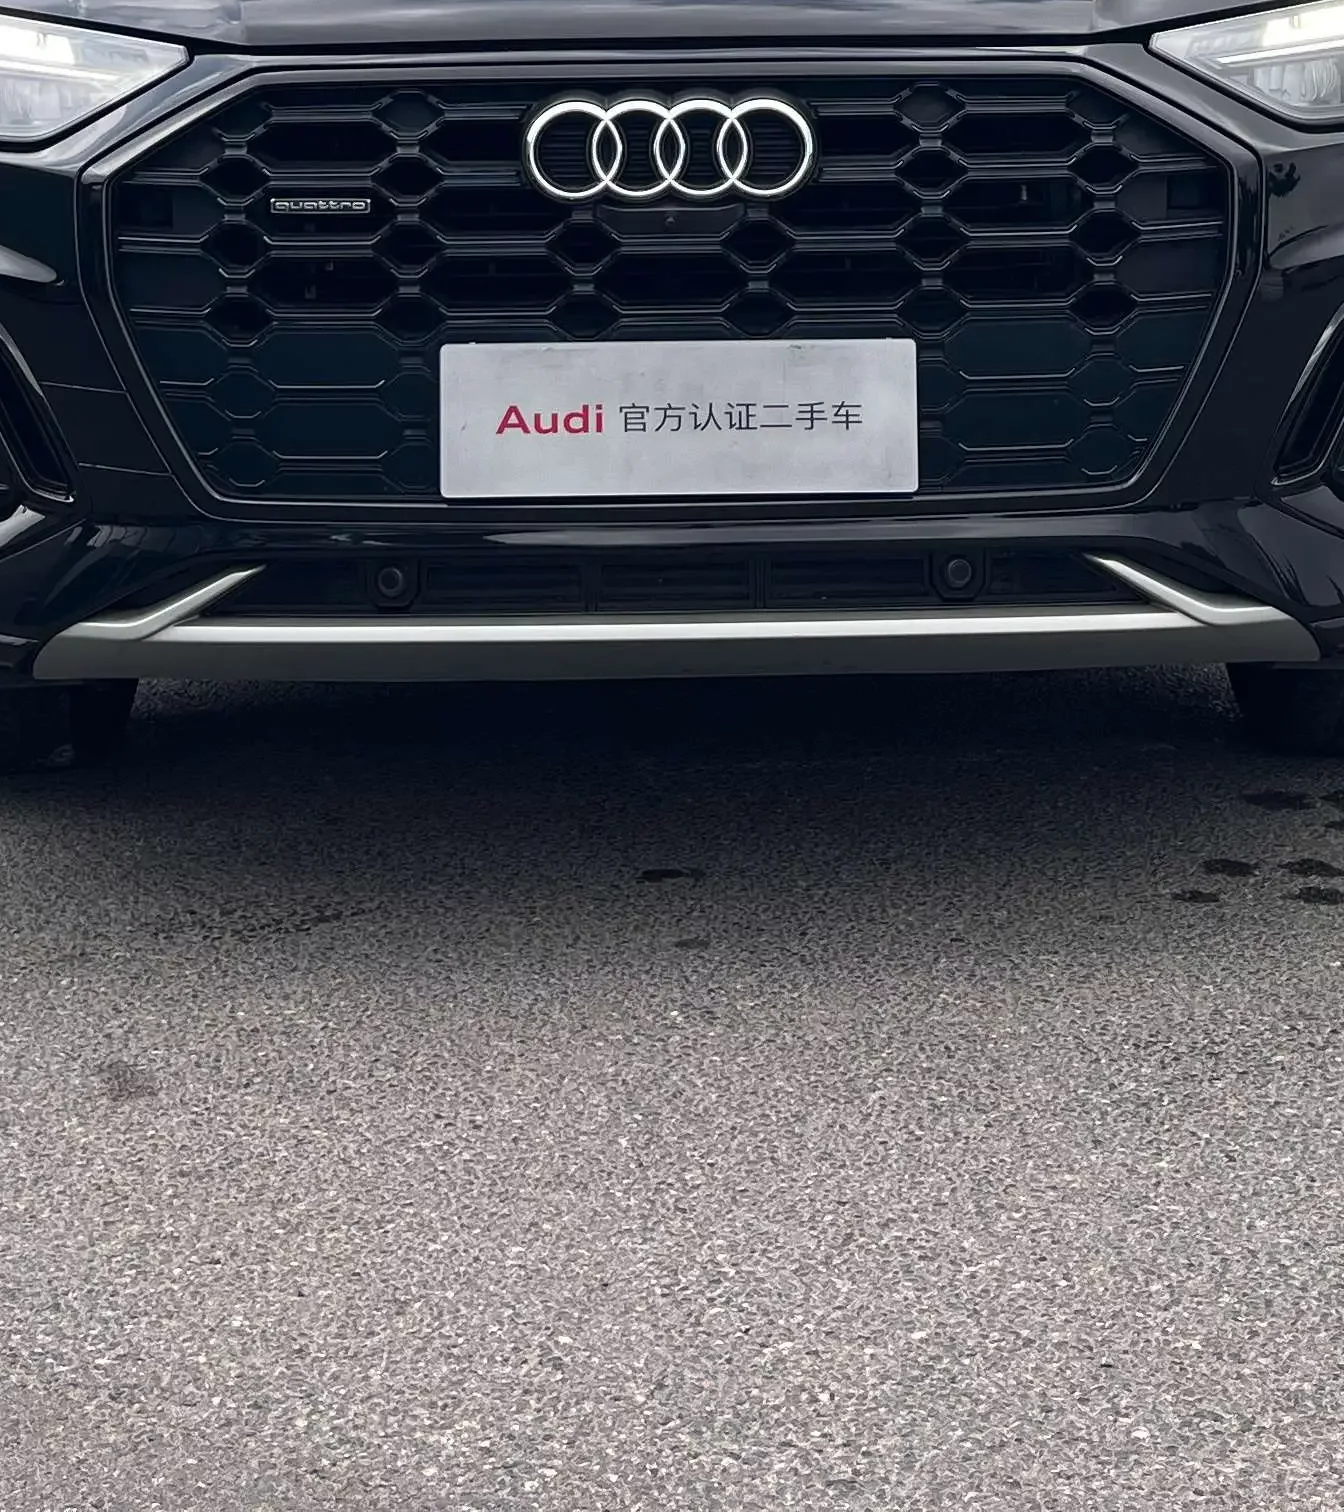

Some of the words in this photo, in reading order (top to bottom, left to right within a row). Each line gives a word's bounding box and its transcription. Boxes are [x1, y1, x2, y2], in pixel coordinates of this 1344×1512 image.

[275, 199, 367, 212] quattro
[496, 403, 604, 435] Audi
[619, 400, 864, 434] 官方认证二手车
